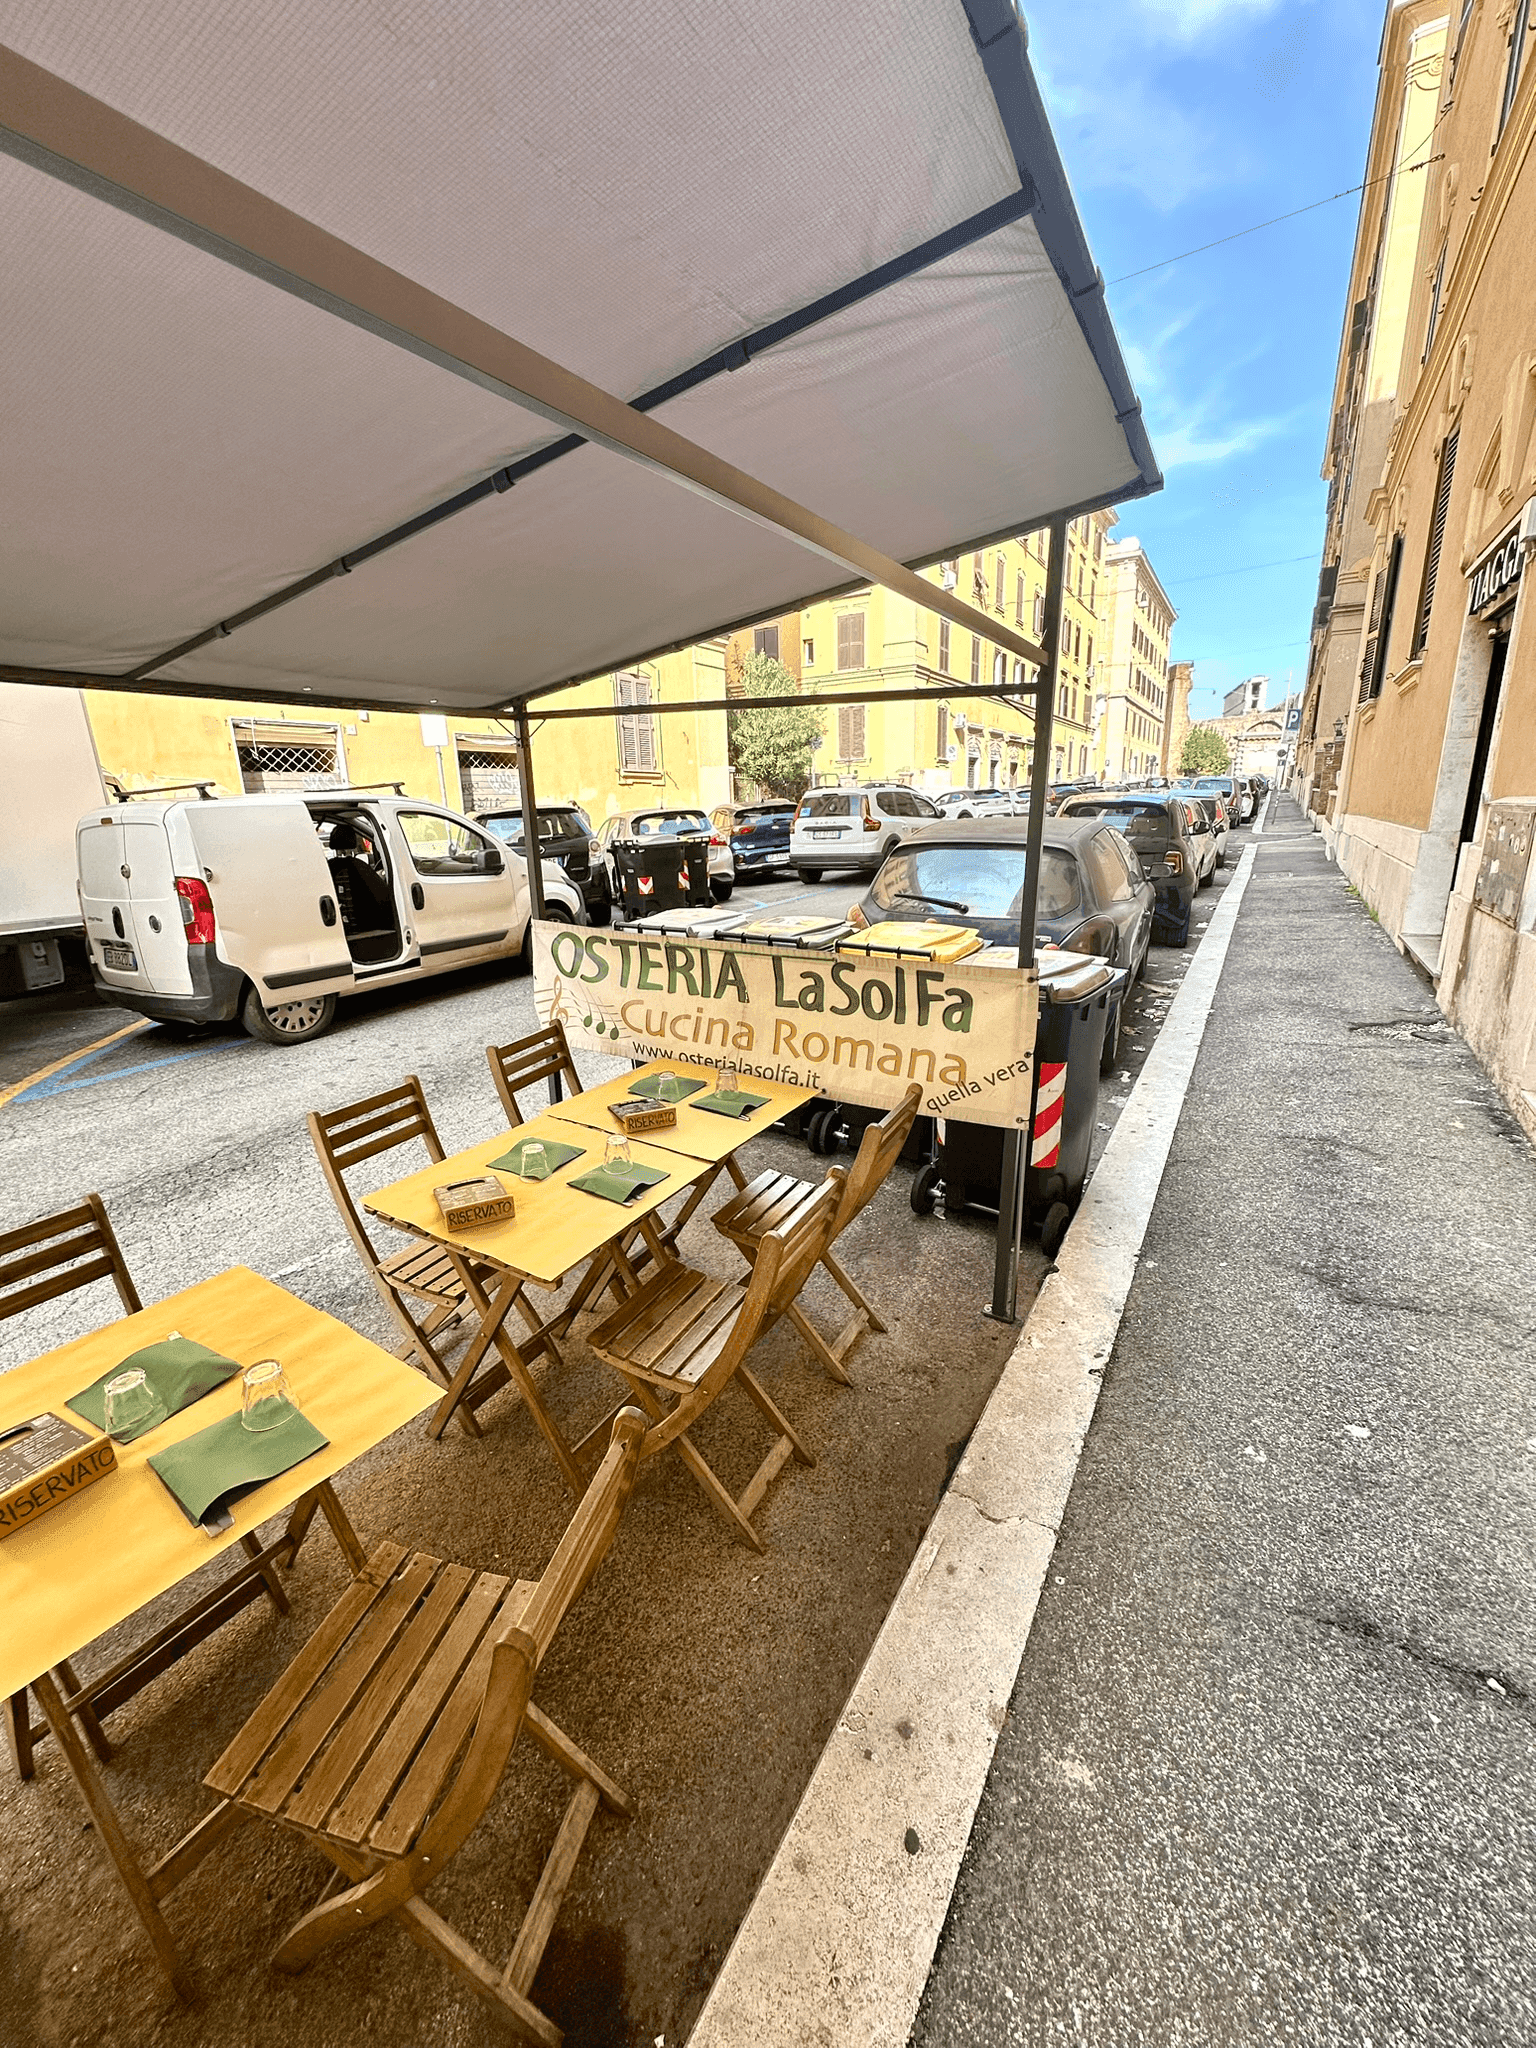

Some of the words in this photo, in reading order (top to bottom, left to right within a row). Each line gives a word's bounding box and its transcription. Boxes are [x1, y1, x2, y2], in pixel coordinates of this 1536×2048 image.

[1468, 534, 1521, 612] VIAGGI
[1288, 711, 1298, 728] P
[550, 931, 750, 1003] OSTERIA
[772, 955, 974, 1033] LaSolFa
[620, 999, 755, 1051] Cucina
[772, 1018, 967, 1086] Romana
[632, 1041, 821, 1089] www.osterialasolfa.it
[926, 1080, 982, 1113] quella
[983, 1058, 1029, 1087] vera
[628, 1111, 675, 1130] RISERVATO
[448, 1201, 512, 1226] RISERVATO
